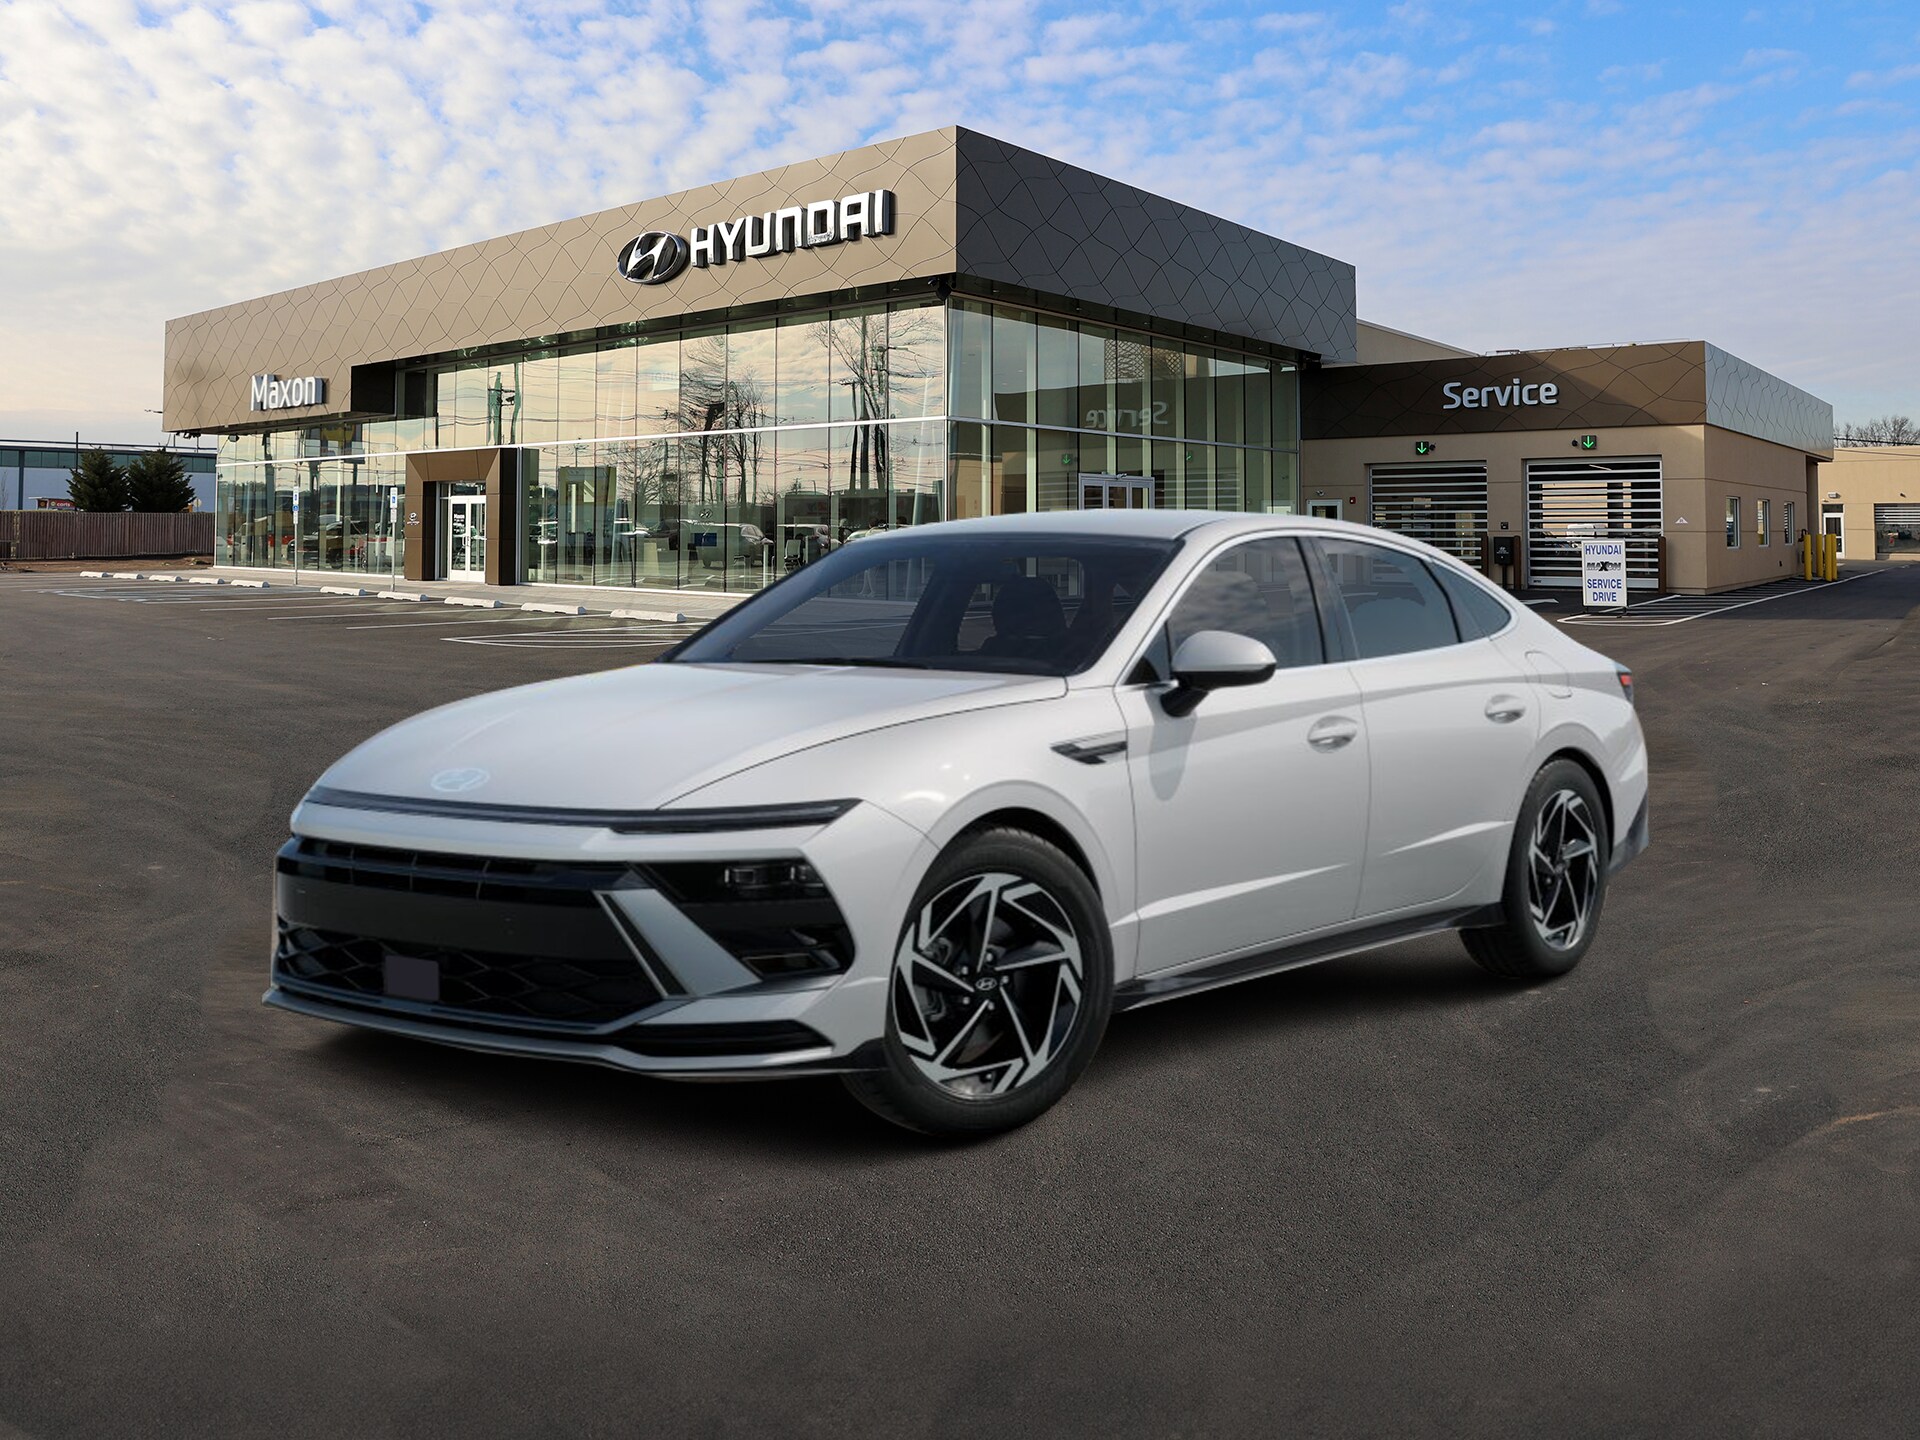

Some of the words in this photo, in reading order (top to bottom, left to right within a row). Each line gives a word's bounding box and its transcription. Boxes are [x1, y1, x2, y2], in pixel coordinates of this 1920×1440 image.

[690, 189, 890, 267] HYUNDAI
[250, 373, 320, 411] Maxon
[1443, 378, 1558, 409] Service
[1585, 545, 1622, 554] HYUNDAI
[1587, 579, 1622, 588] SERVICE
[1592, 592, 1617, 601] DRIVE
